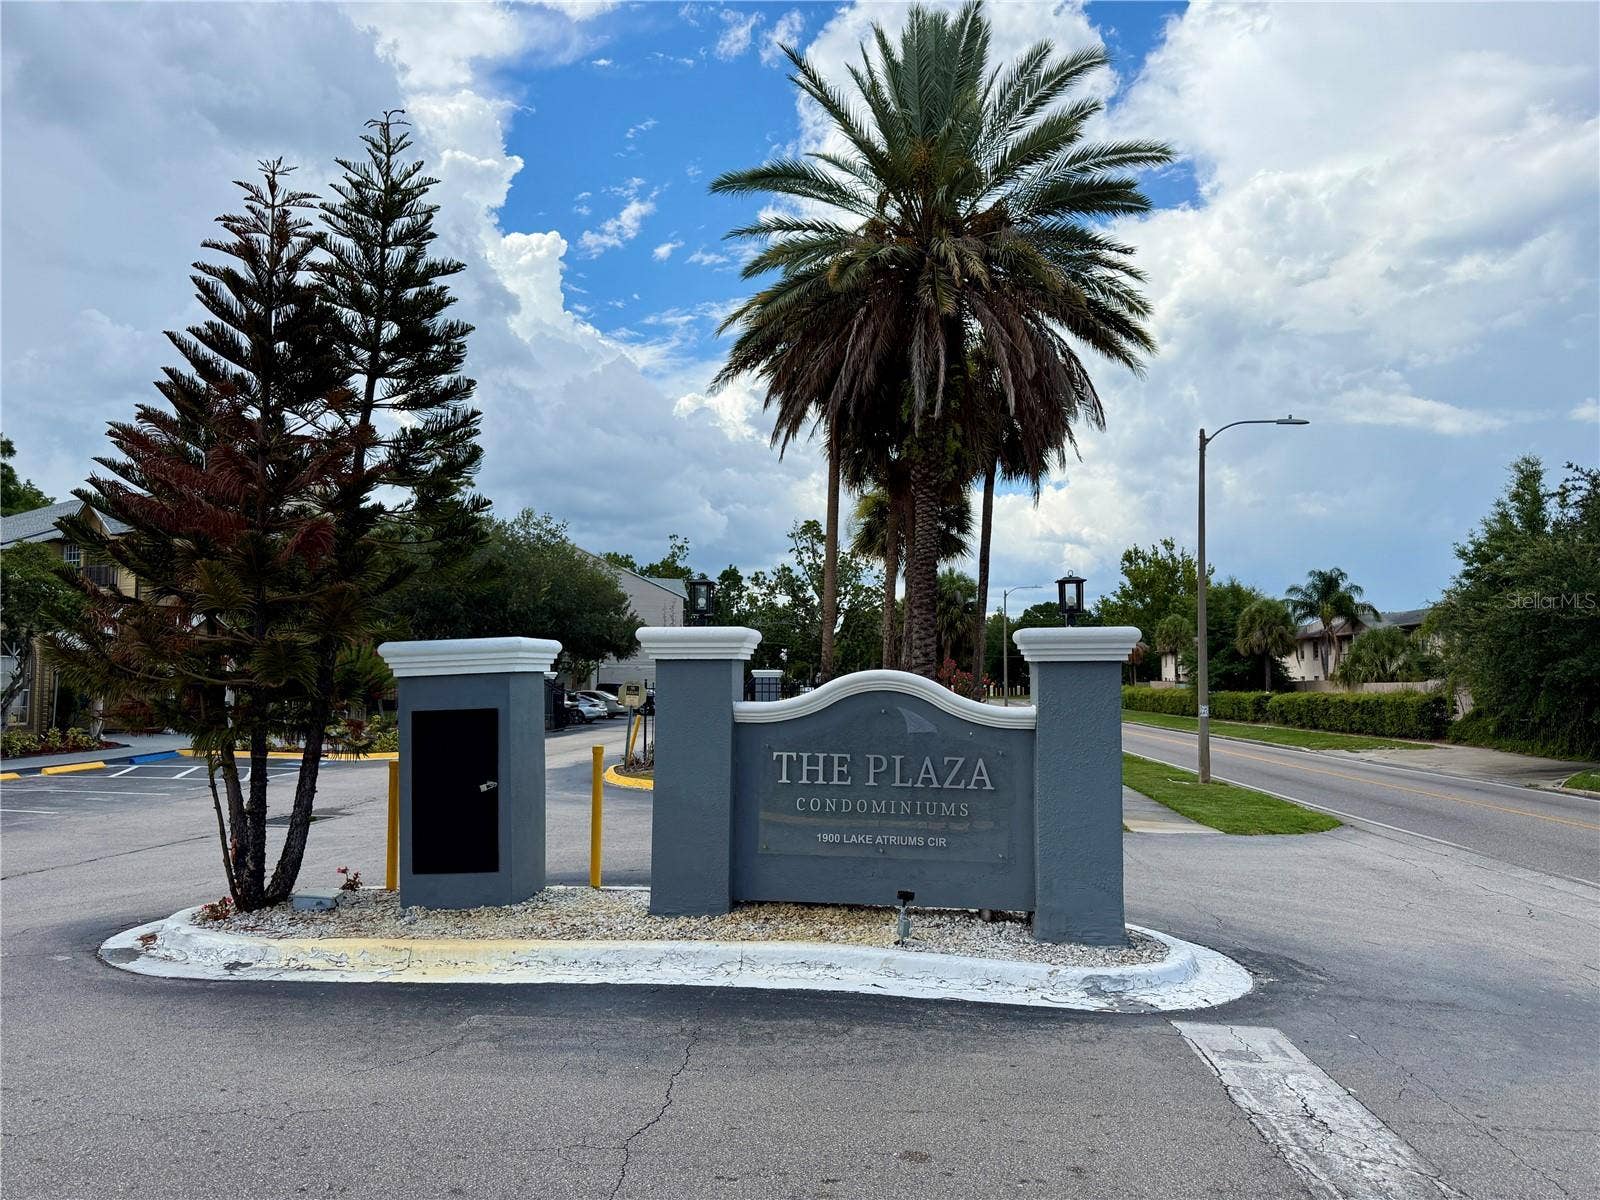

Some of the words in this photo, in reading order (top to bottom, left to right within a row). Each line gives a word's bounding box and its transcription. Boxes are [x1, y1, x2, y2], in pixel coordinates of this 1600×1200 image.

[772, 751, 851, 786] THE
[864, 753, 995, 791] PLAZA
[796, 797, 969, 817] CONDOMINIUMS
[816, 833, 841, 843] 1900
[843, 833, 873, 845] LAKE
[875, 835, 925, 847] ATRIUMS
[927, 837, 947, 848] CIR
